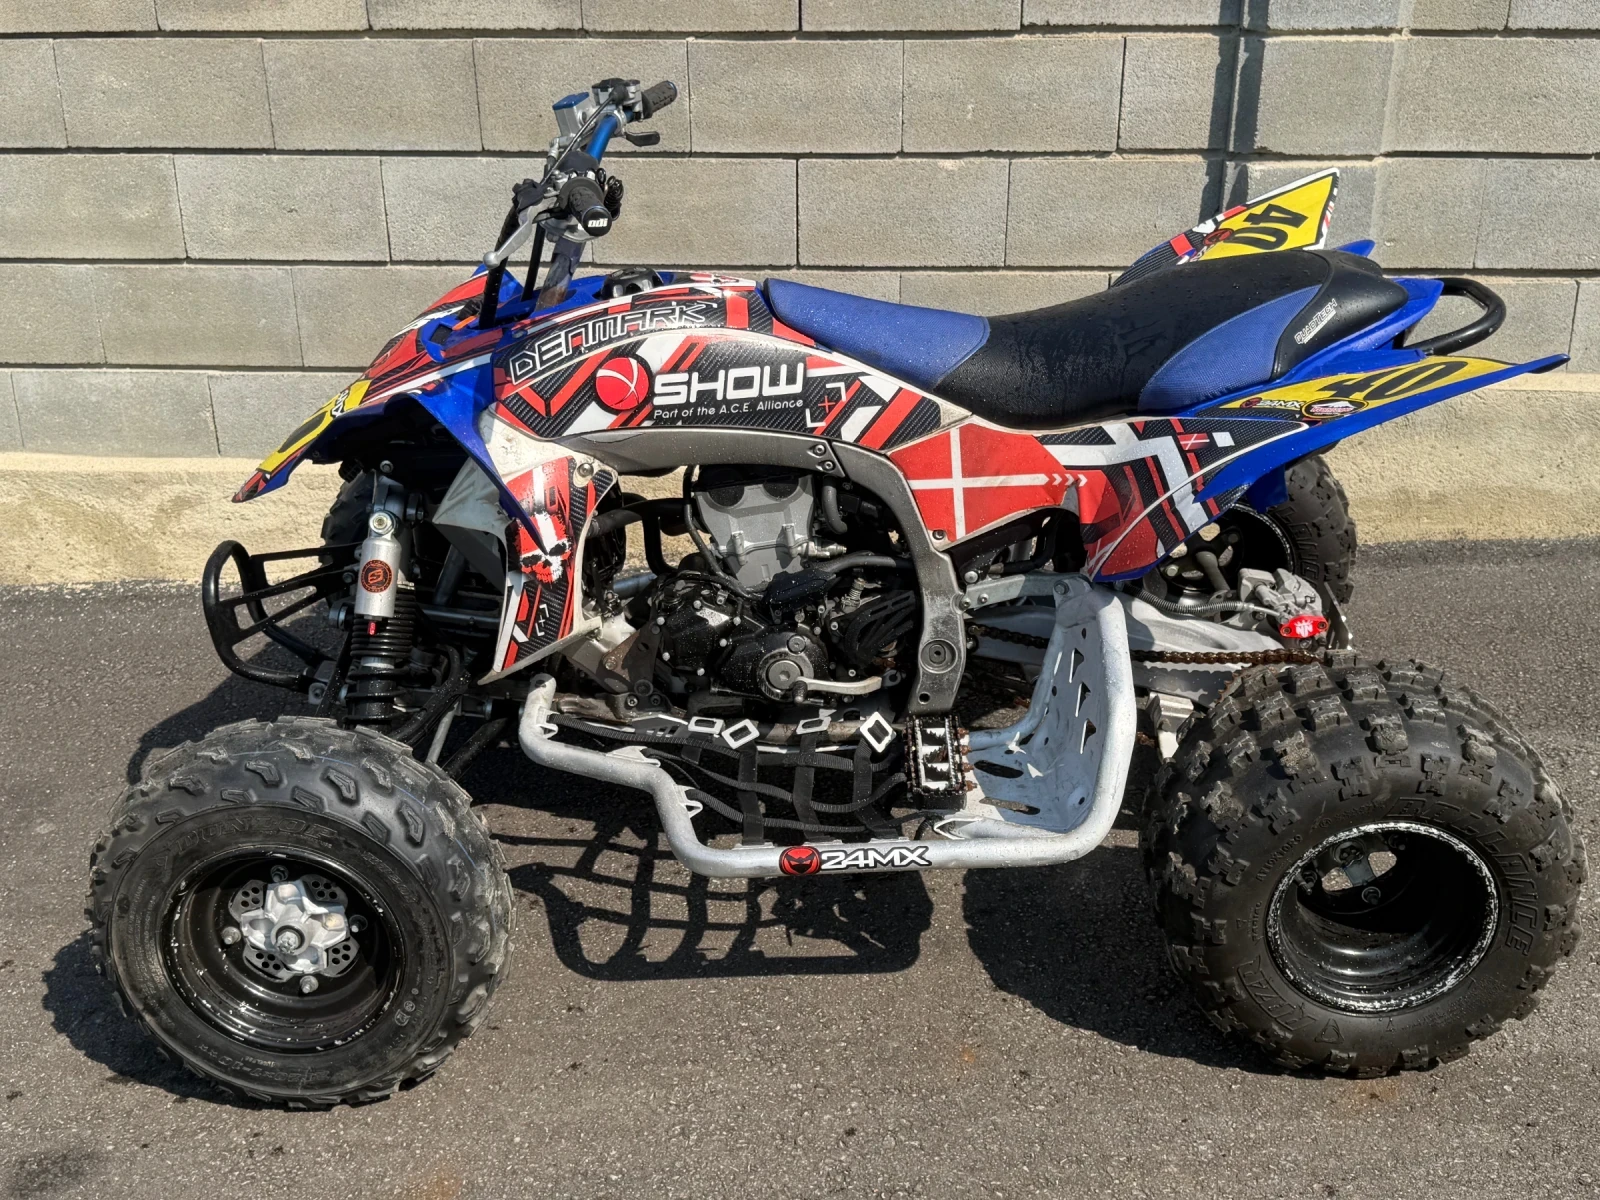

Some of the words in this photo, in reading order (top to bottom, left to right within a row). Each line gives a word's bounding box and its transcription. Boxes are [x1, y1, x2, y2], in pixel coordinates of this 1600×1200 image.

[588, 217, 608, 227] odi
[1223, 204, 1309, 250] 40
[510, 304, 709, 385] DENMARK
[653, 362, 804, 406] SHOW
[1316, 361, 1468, 400] 40
[653, 408, 679, 419] Part
[682, 407, 694, 418] of
[697, 406, 716, 416] the
[719, 403, 752, 414] A.C.E.
[757, 399, 804, 411] Alliance
[177, 816, 338, 855] DUNLOP
[821, 847, 931, 870] 24MX
[1237, 954, 1319, 1031] RAZR
